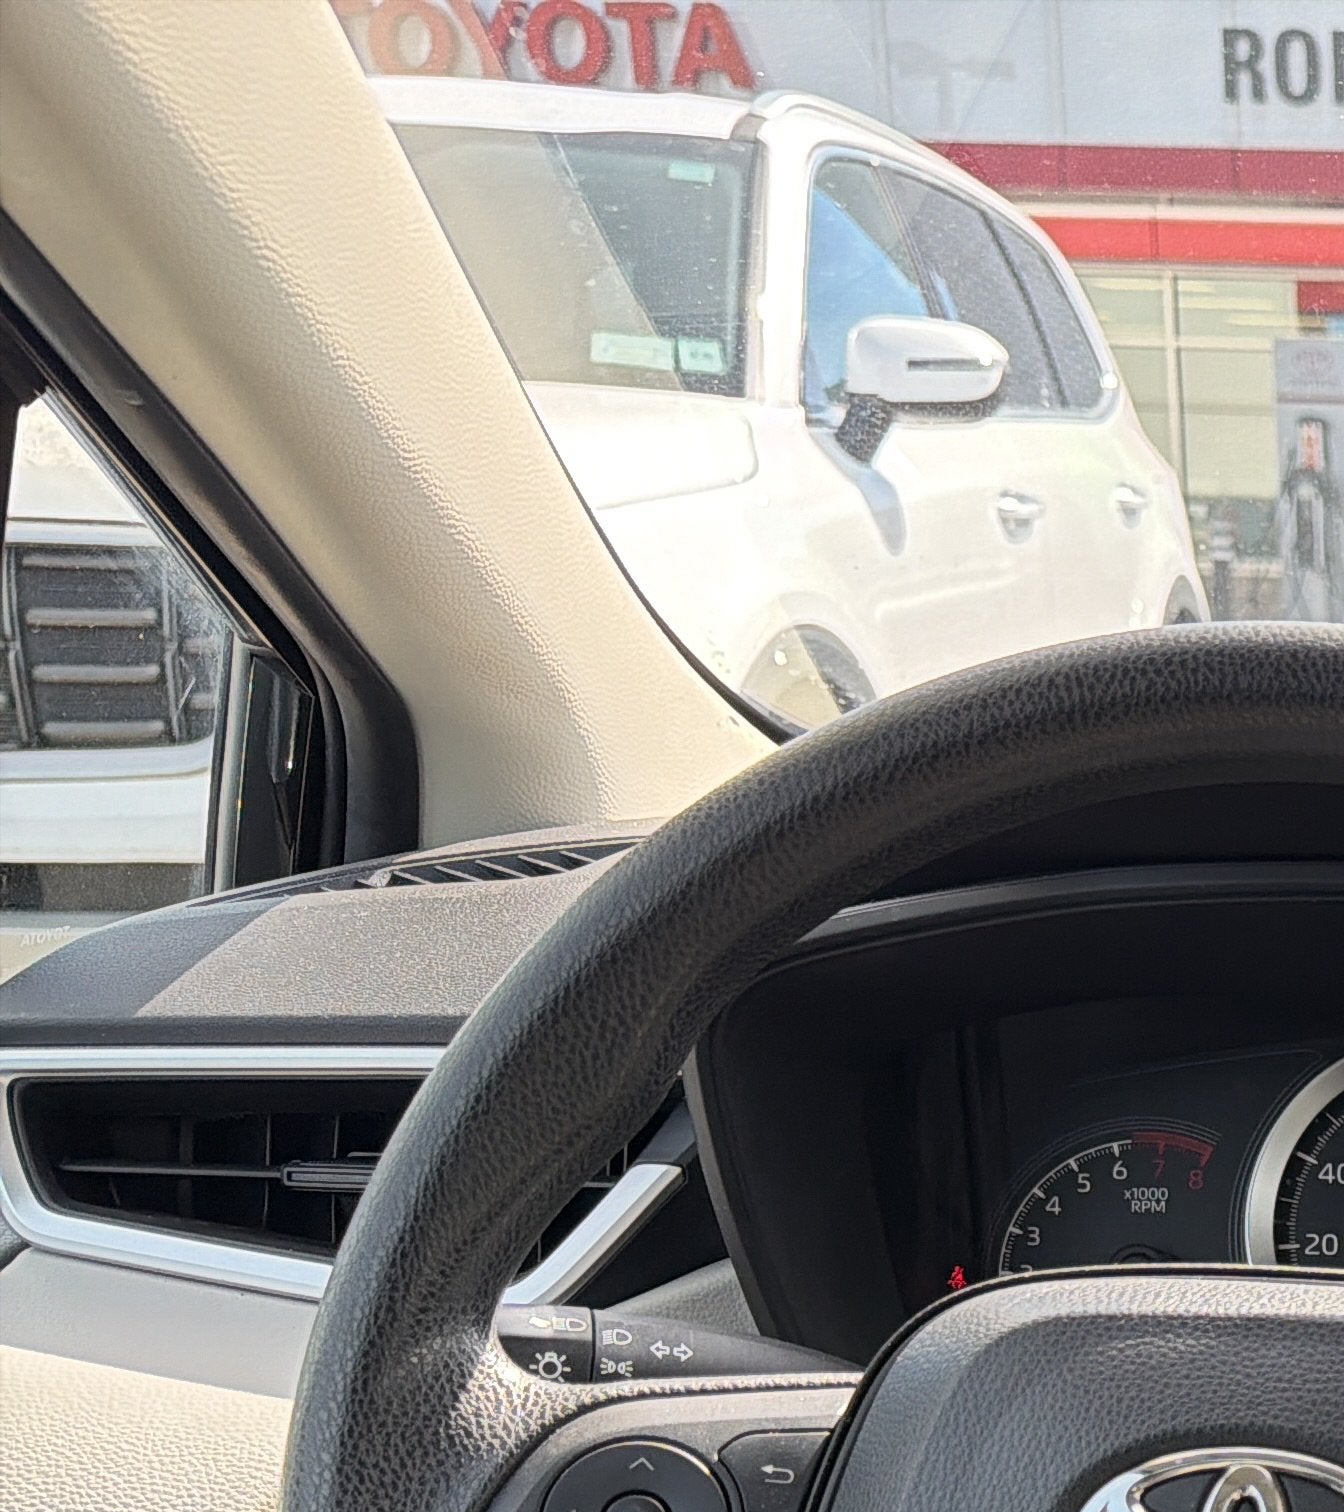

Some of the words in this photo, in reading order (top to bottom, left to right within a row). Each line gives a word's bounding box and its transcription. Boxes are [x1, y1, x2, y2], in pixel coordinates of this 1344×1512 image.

[337, 0, 758, 91] OYOTA
[1112, 1160, 1128, 1180] 6
[1153, 1160, 1166, 1178] 7
[1077, 1173, 1091, 1193] 5
[1188, 1170, 1204, 1190] 8
[1123, 1187, 1169, 1201] x1000
[1045, 1196, 1062, 1216] 4
[1131, 1200, 1166, 1213] RPM
[1027, 1227, 1041, 1246] 3
[1304, 1234, 1339, 1256] 20
